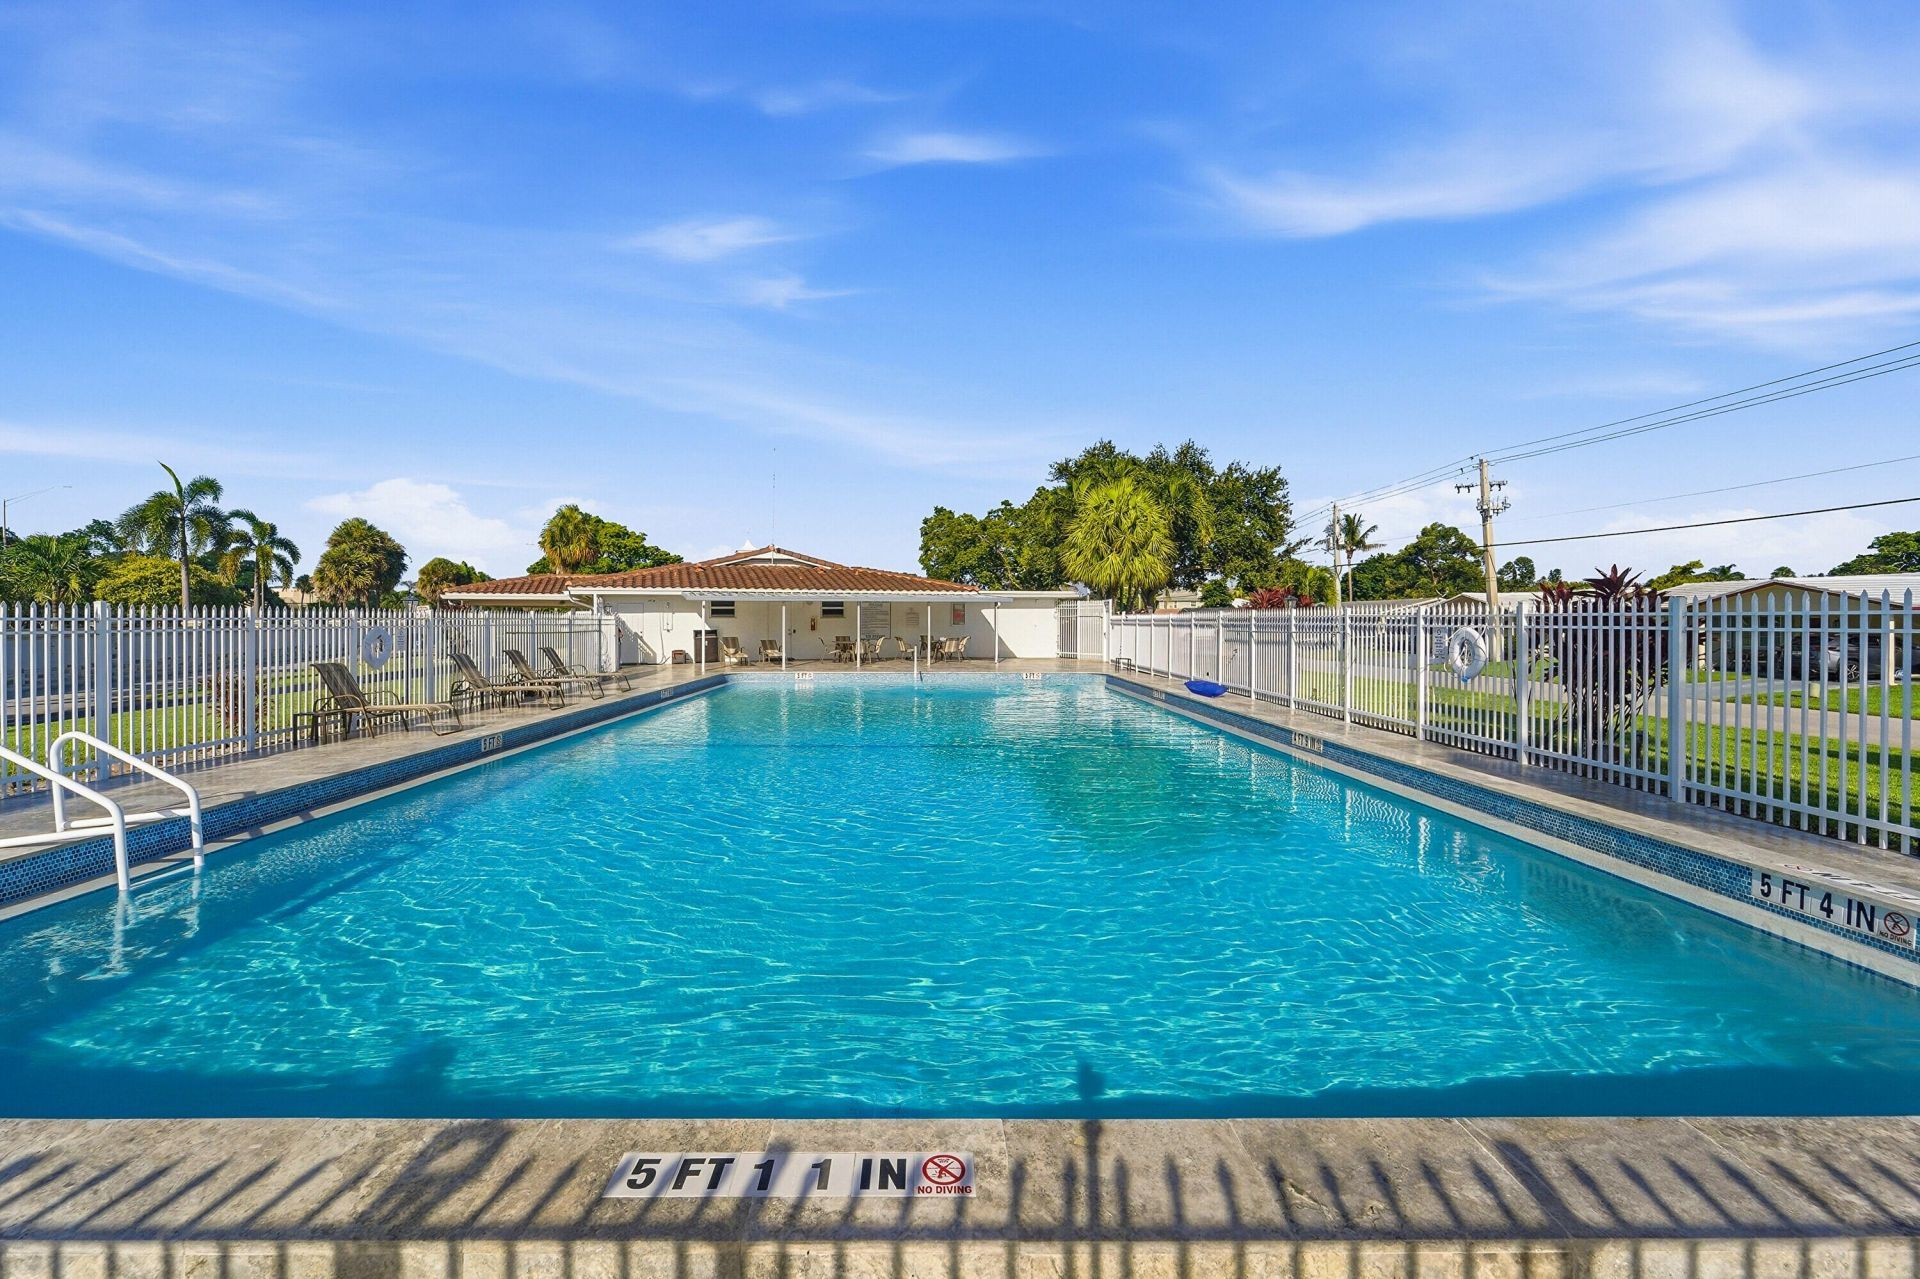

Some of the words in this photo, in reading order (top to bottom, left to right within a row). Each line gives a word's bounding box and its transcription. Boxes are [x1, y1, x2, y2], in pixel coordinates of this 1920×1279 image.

[489, 736, 496, 749] FT
[1760, 872, 1772, 898] 5
[1781, 879, 1810, 910] FT
[1820, 892, 1834, 919] 4
[1846, 899, 1876, 933] IN
[1879, 930, 1889, 939] NO
[1890, 934, 1913, 947] DIVING
[626, 1158, 662, 1190] 5
[671, 1158, 734, 1190] FT
[859, 1158, 906, 1190] IN
[917, 1185, 933, 1194] NO
[936, 1185, 973, 1194] DIVING
